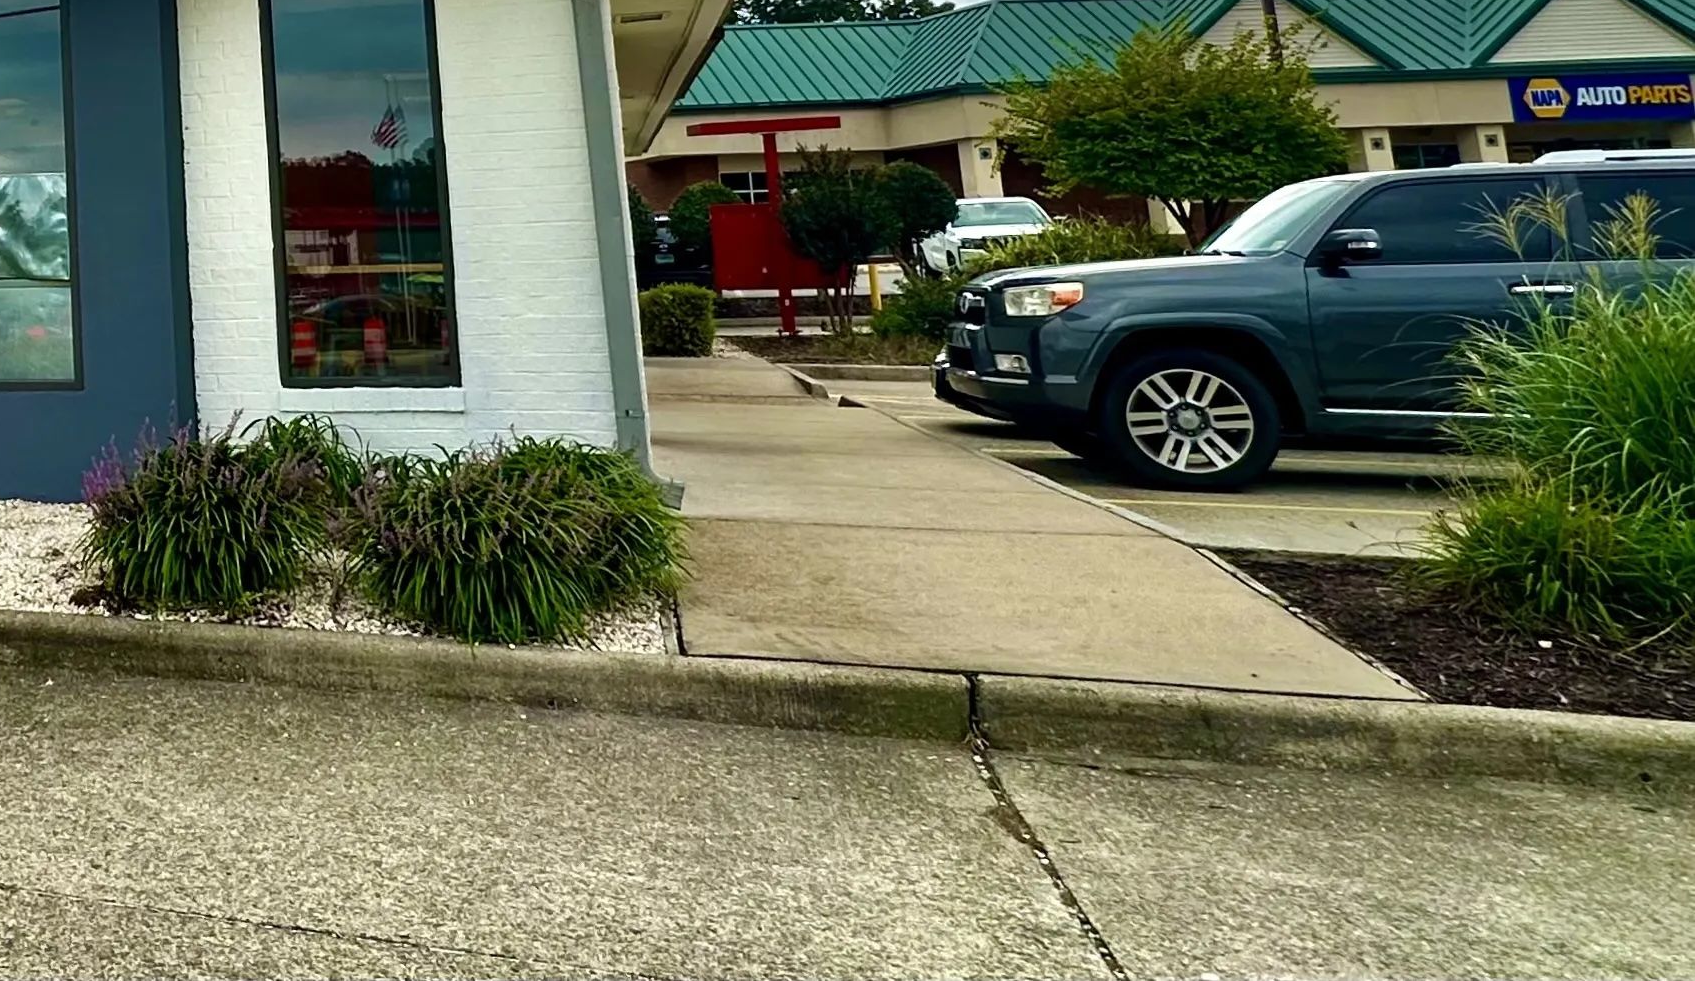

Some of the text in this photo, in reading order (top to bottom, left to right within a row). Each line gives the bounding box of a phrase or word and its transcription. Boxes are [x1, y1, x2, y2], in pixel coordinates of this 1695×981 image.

[1531, 84, 1692, 107] NAPA AUTO PARTS
